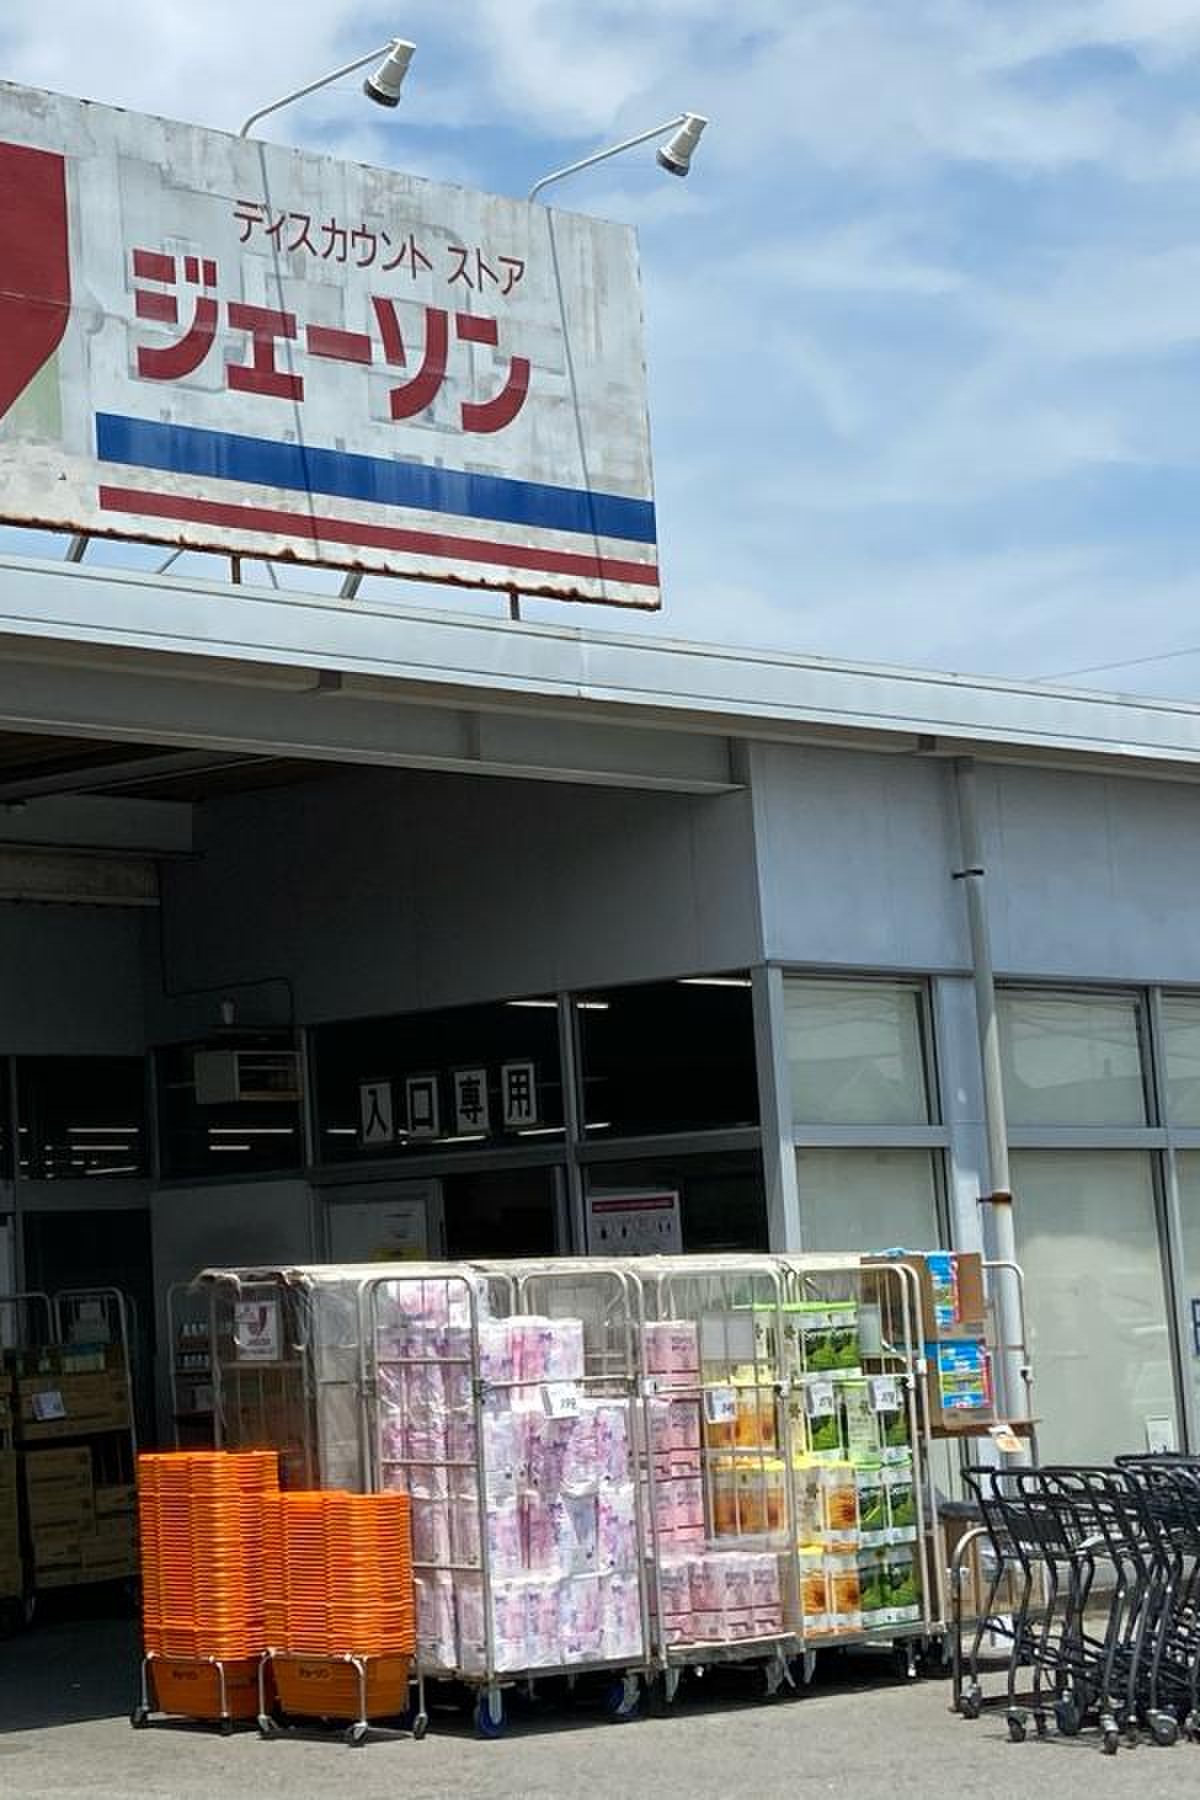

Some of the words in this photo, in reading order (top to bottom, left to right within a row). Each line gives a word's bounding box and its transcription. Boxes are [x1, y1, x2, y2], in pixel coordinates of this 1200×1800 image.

[233, 200, 432, 279] ディスカウント
[448, 246, 524, 294] ストア
[133, 247, 530, 435] ジェーソン
[365, 1069, 531, 1136] 入口専用
